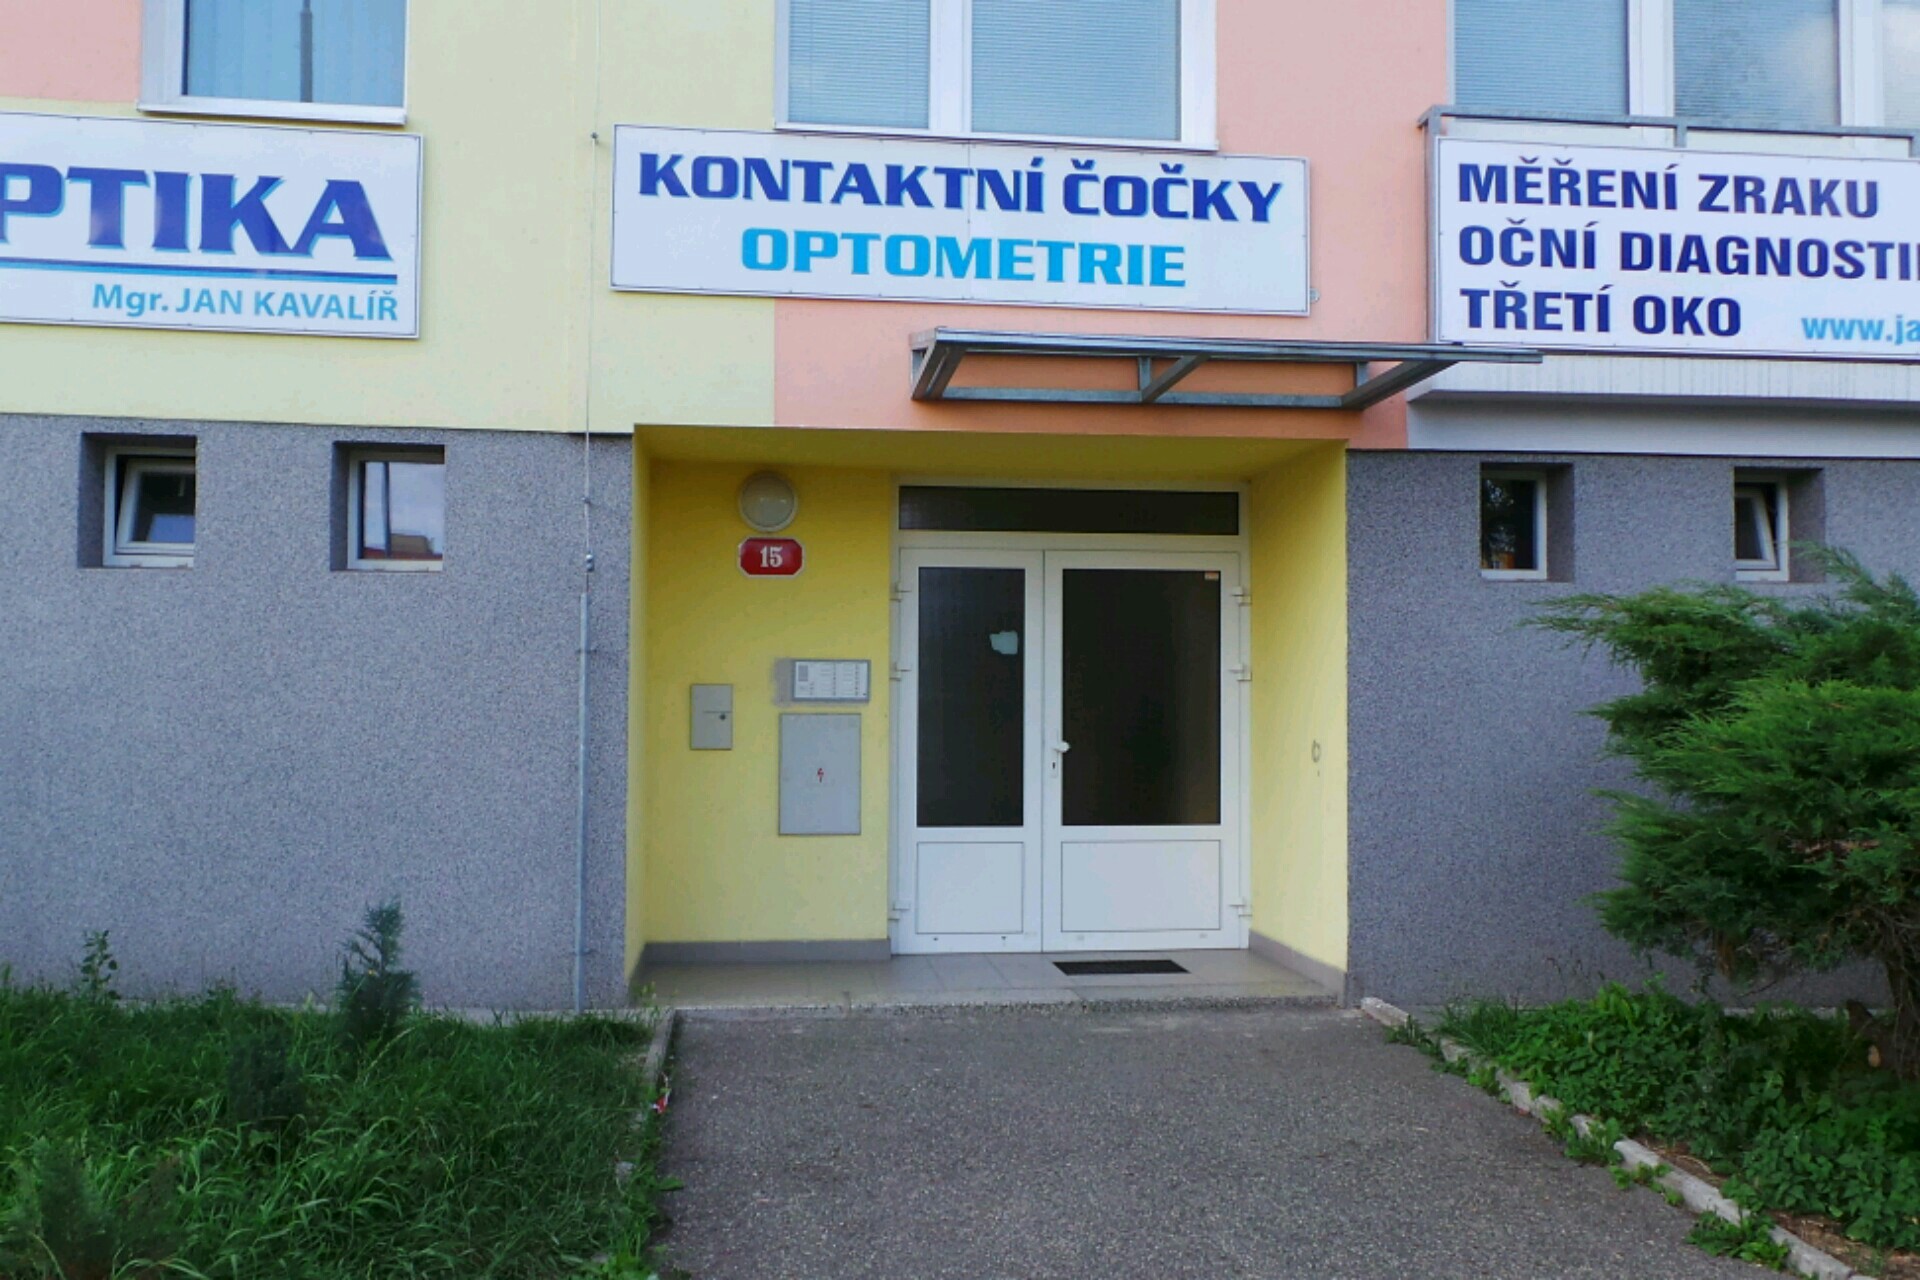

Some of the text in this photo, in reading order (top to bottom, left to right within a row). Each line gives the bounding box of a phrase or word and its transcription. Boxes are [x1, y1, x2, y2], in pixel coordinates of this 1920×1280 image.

[638, 152, 1284, 224] KONTAKTNÍ ČOČKY
[1458, 156, 1880, 219] MĚŘENÍ ZRAKU
[740, 226, 1187, 288] OPTOMETRIE
[1458, 217, 1920, 282] OČNÍ DIAGNOSTI
[92, 283, 399, 321] Mgr. JAN KAVALÍŘ
[1459, 279, 1742, 338] TŘETÍ OKO
[760, 545, 783, 568] 15
